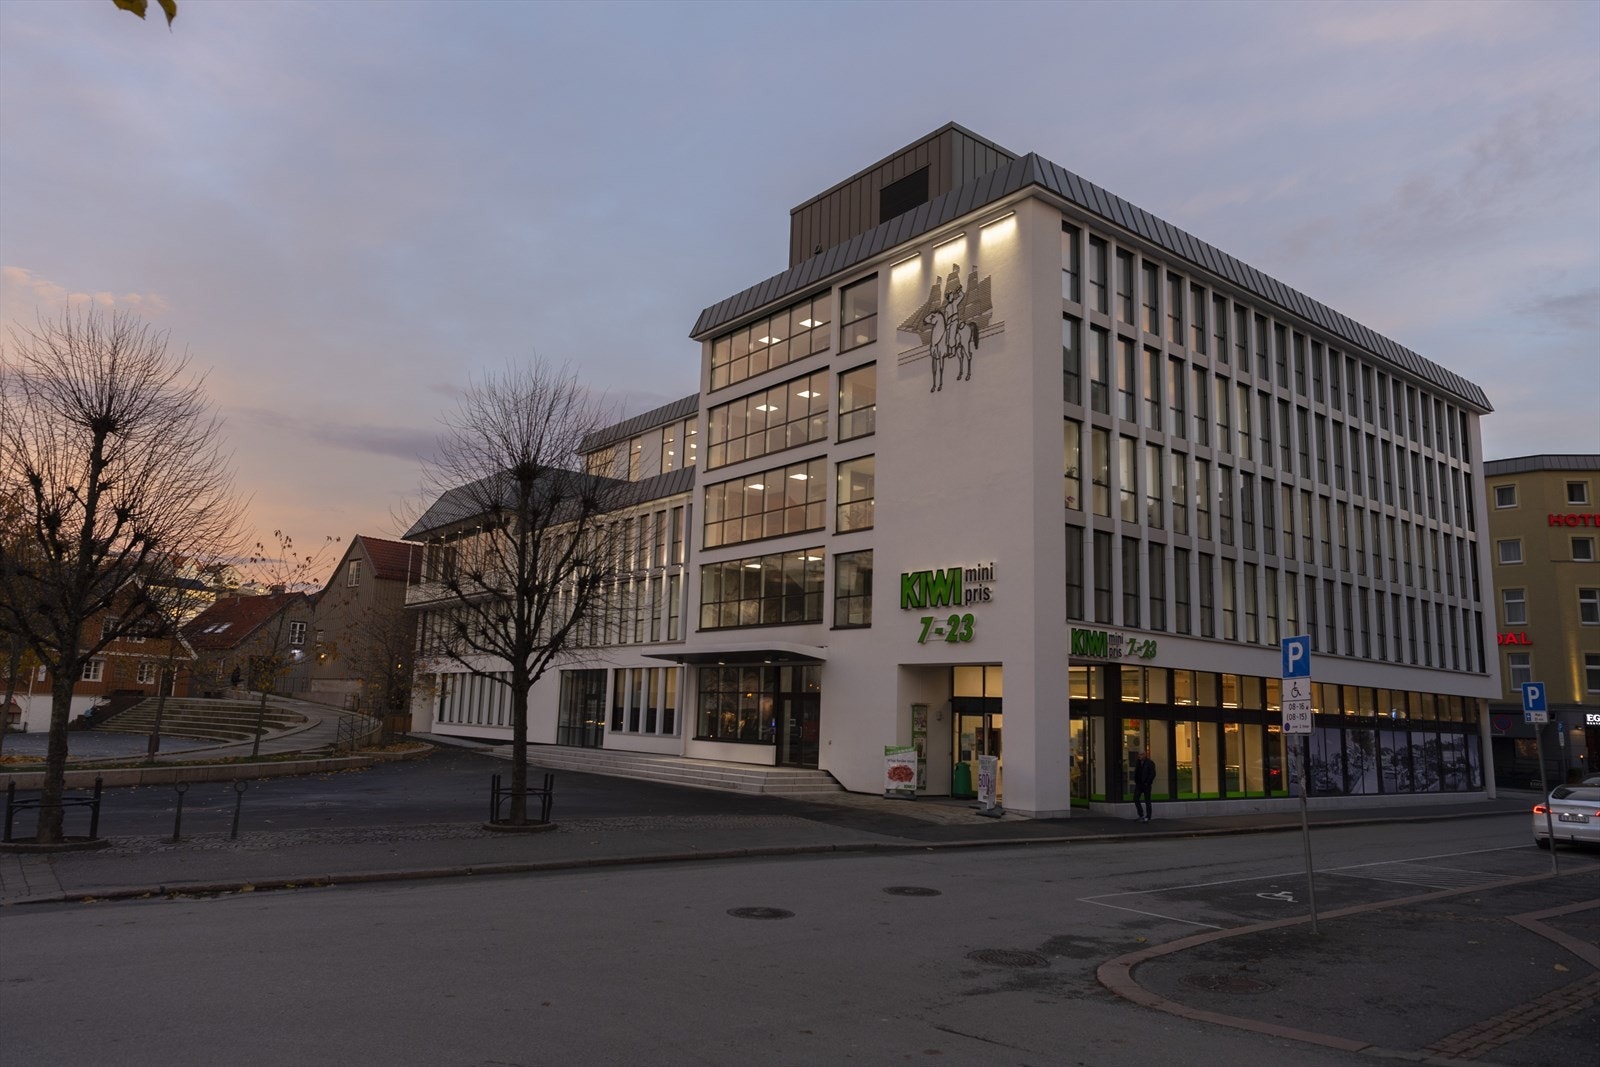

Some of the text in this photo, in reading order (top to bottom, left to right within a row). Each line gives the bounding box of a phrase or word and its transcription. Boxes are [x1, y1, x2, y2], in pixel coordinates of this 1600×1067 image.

[900, 562, 993, 609] KIWI mini
[966, 584, 991, 606] pris
[1071, 628, 1108, 658] KIWI
[1109, 632, 1124, 645] mini
[1109, 646, 1123, 658] pris
[1288, 641, 1304, 673] P
[1527, 686, 1540, 708] P
